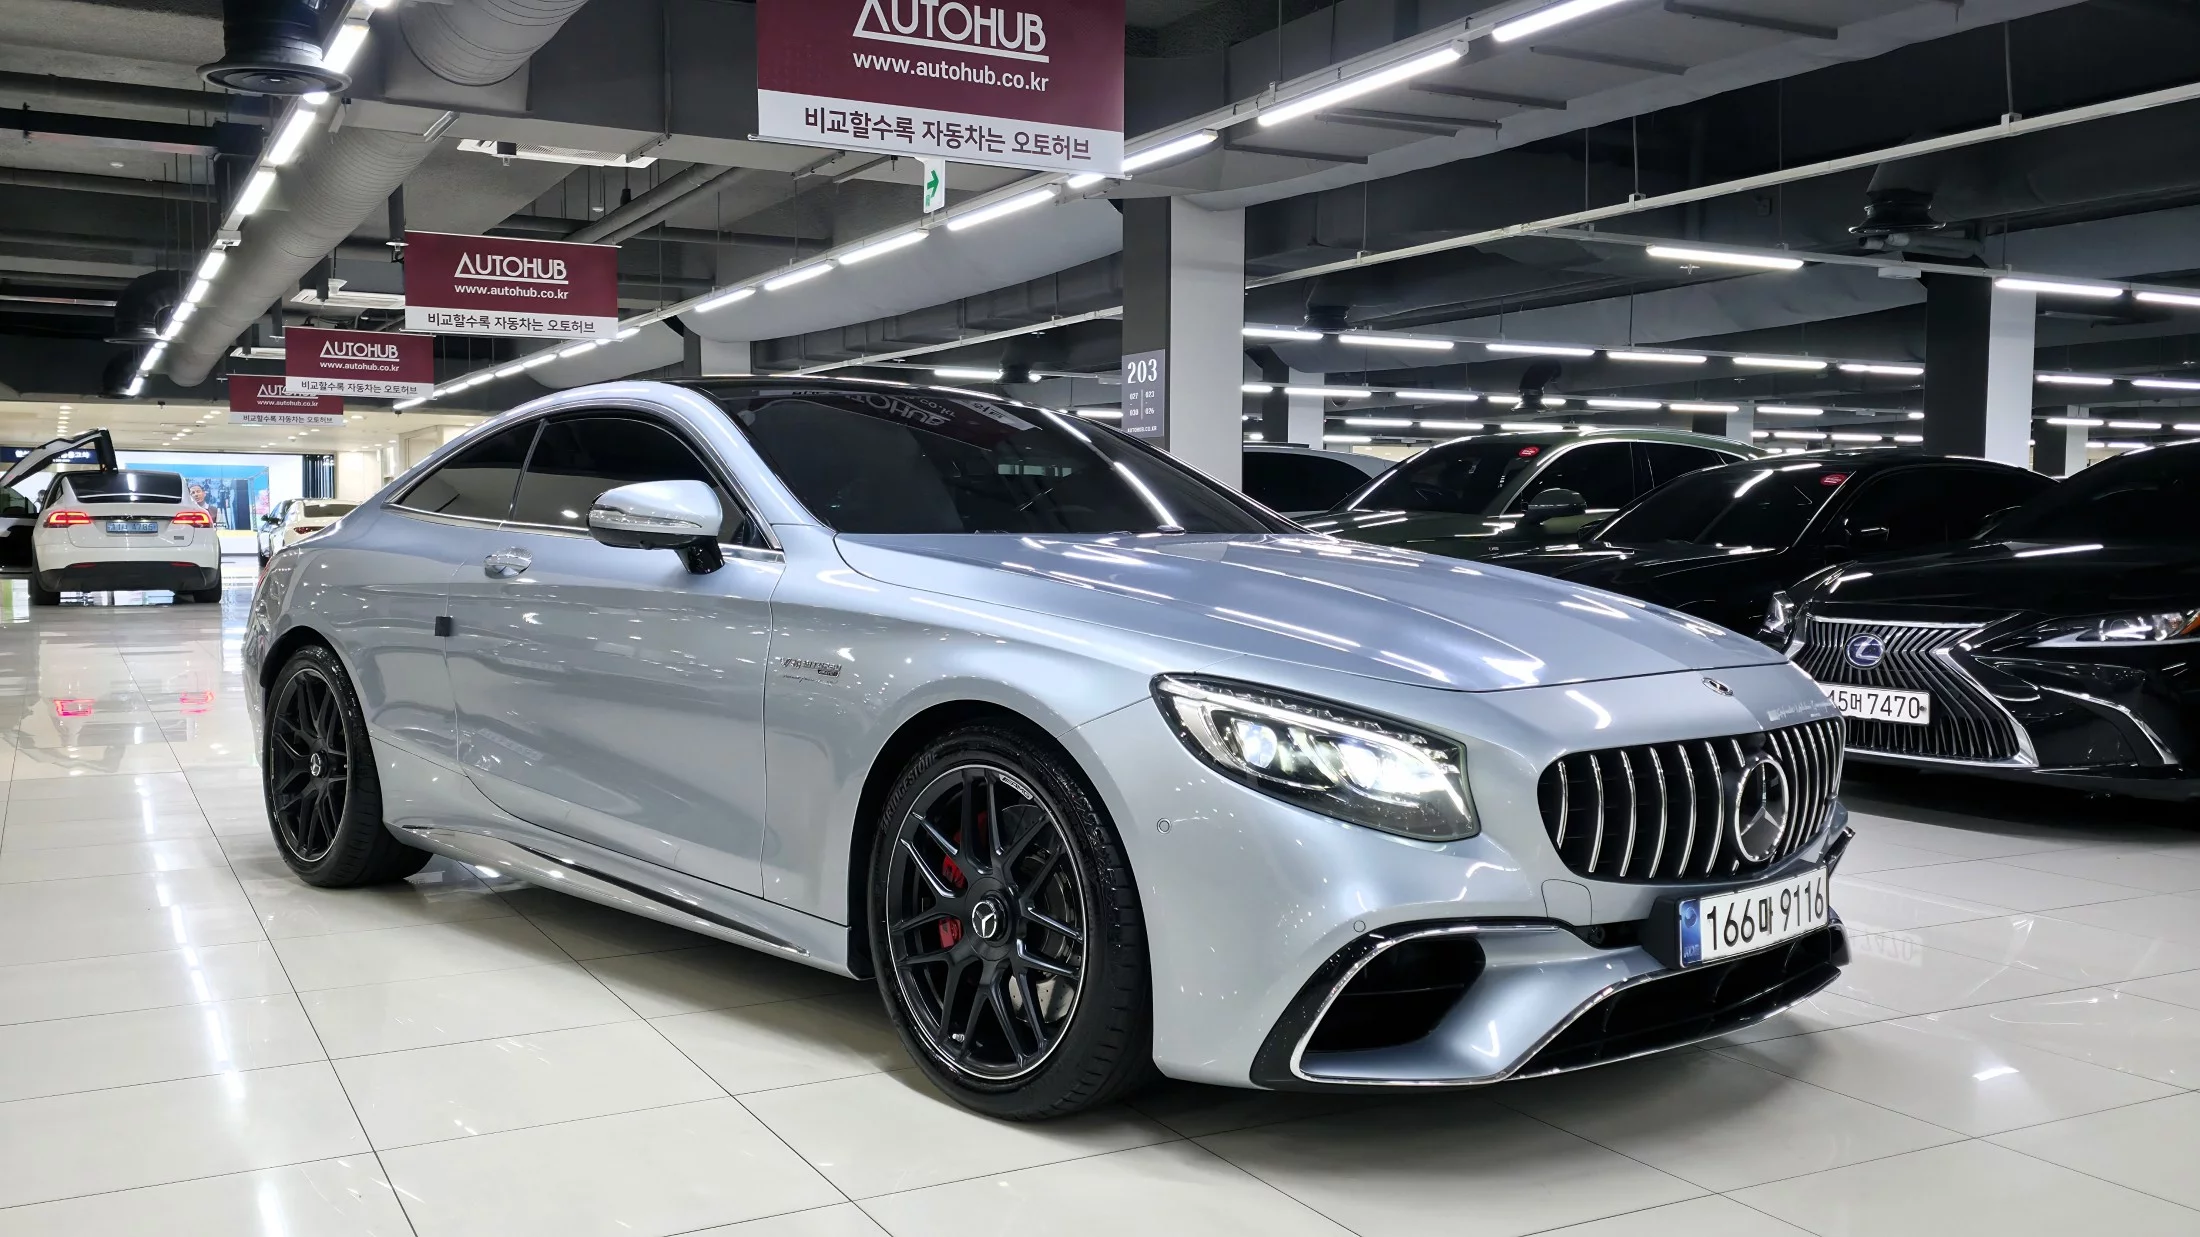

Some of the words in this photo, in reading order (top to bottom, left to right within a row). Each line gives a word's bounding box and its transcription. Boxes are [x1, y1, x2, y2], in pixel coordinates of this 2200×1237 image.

[853, 0, 1047, 54] AUTOHUB
[852, 52, 1049, 92] www.autohub.co.kr
[804, 106, 915, 145] 비교할수록
[922, 120, 1006, 154] 자동차는
[1011, 131, 1091, 160] 오토허브
[454, 252, 567, 281] AUTOHUB
[454, 284, 568, 300] www.autohub.co.kr
[427, 313, 490, 330] 비교할수록
[494, 317, 544, 332] 자동차는
[547, 320, 595, 334] 오토허브
[319, 340, 398, 359] AUTOHUB
[319, 361, 400, 372] www.autohub.co.kr
[1127, 358, 1158, 384] 203
[301, 380, 345, 392] 비교할수록
[347, 383, 382, 394] 자동차는
[384, 385, 418, 395] 오토허브
[1867, 693, 1920, 719] 7470
[1706, 896, 1774, 951] 166마
[1780, 877, 1824, 932] 9116
